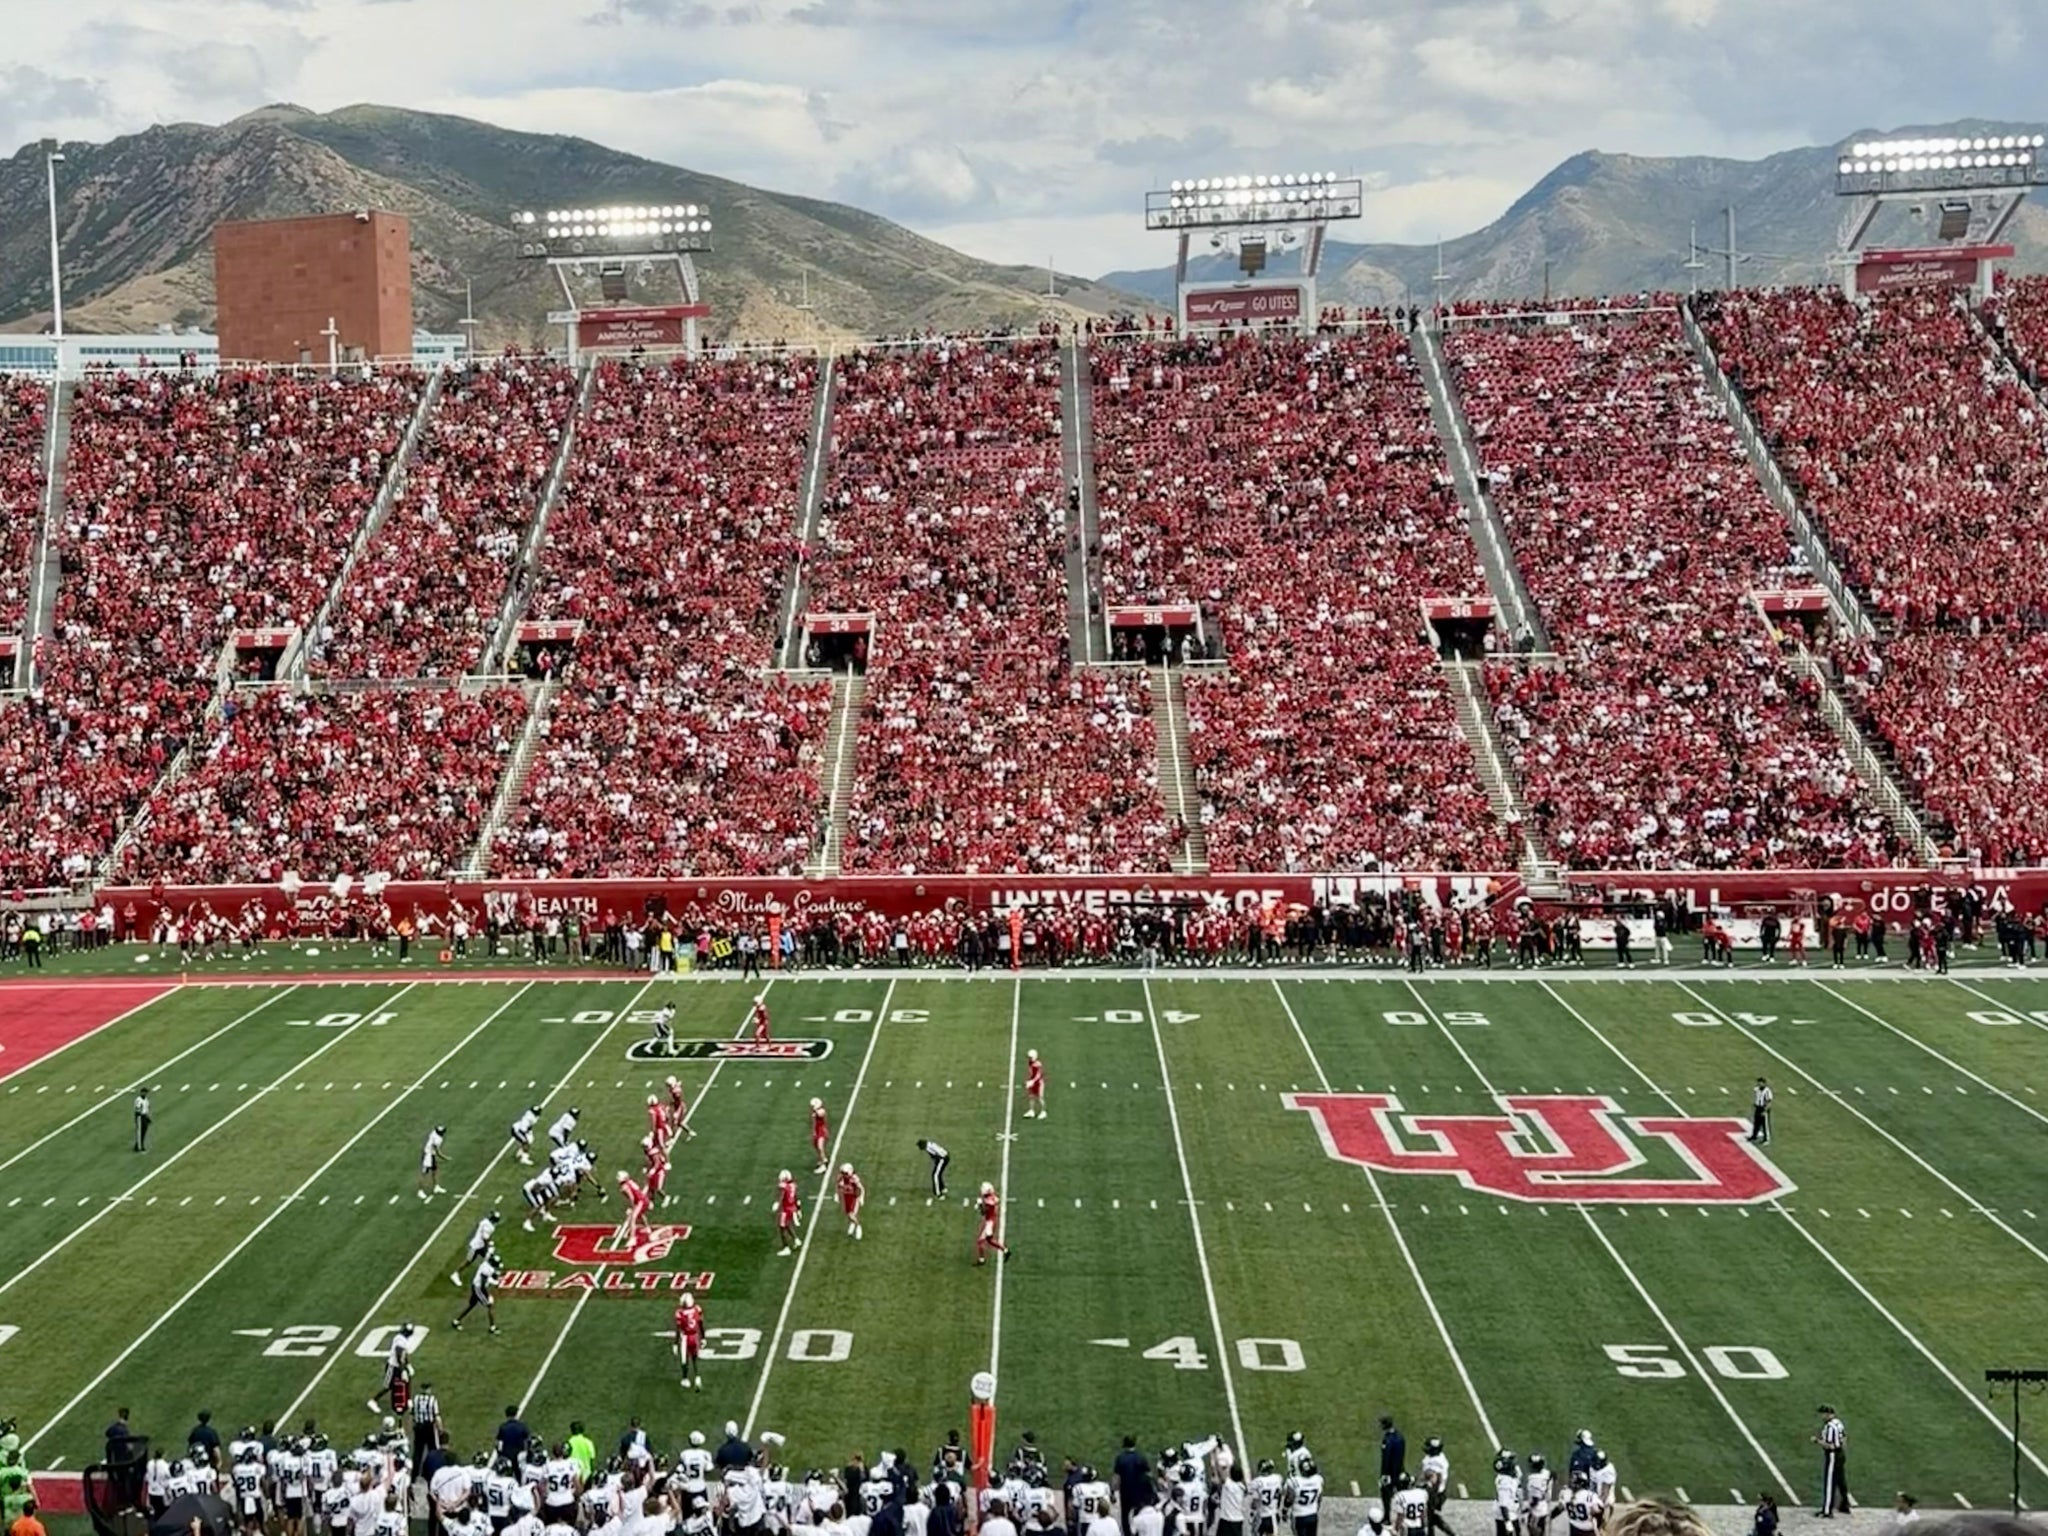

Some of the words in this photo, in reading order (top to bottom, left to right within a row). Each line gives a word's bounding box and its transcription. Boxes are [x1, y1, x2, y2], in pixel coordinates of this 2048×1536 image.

[1252, 296, 1267, 311] GO
[1783, 598, 1803, 610] 37
[830, 620, 849, 631] 34
[1143, 612, 1163, 625] 35
[254, 635, 272, 647] 32
[538, 629, 557, 640] 33
[794, 889, 863, 913] Couture
[262, 1325, 430, 1357] 20
[698, 1328, 854, 1361] 30
[1142, 1336, 1307, 1371] 40
[1604, 1345, 1790, 1379] 50
[237, 1476, 256, 1492] 28
[548, 1474, 570, 1492] 54
[488, 1489, 503, 1506] 51
[1298, 1489, 1318, 1506] 57
